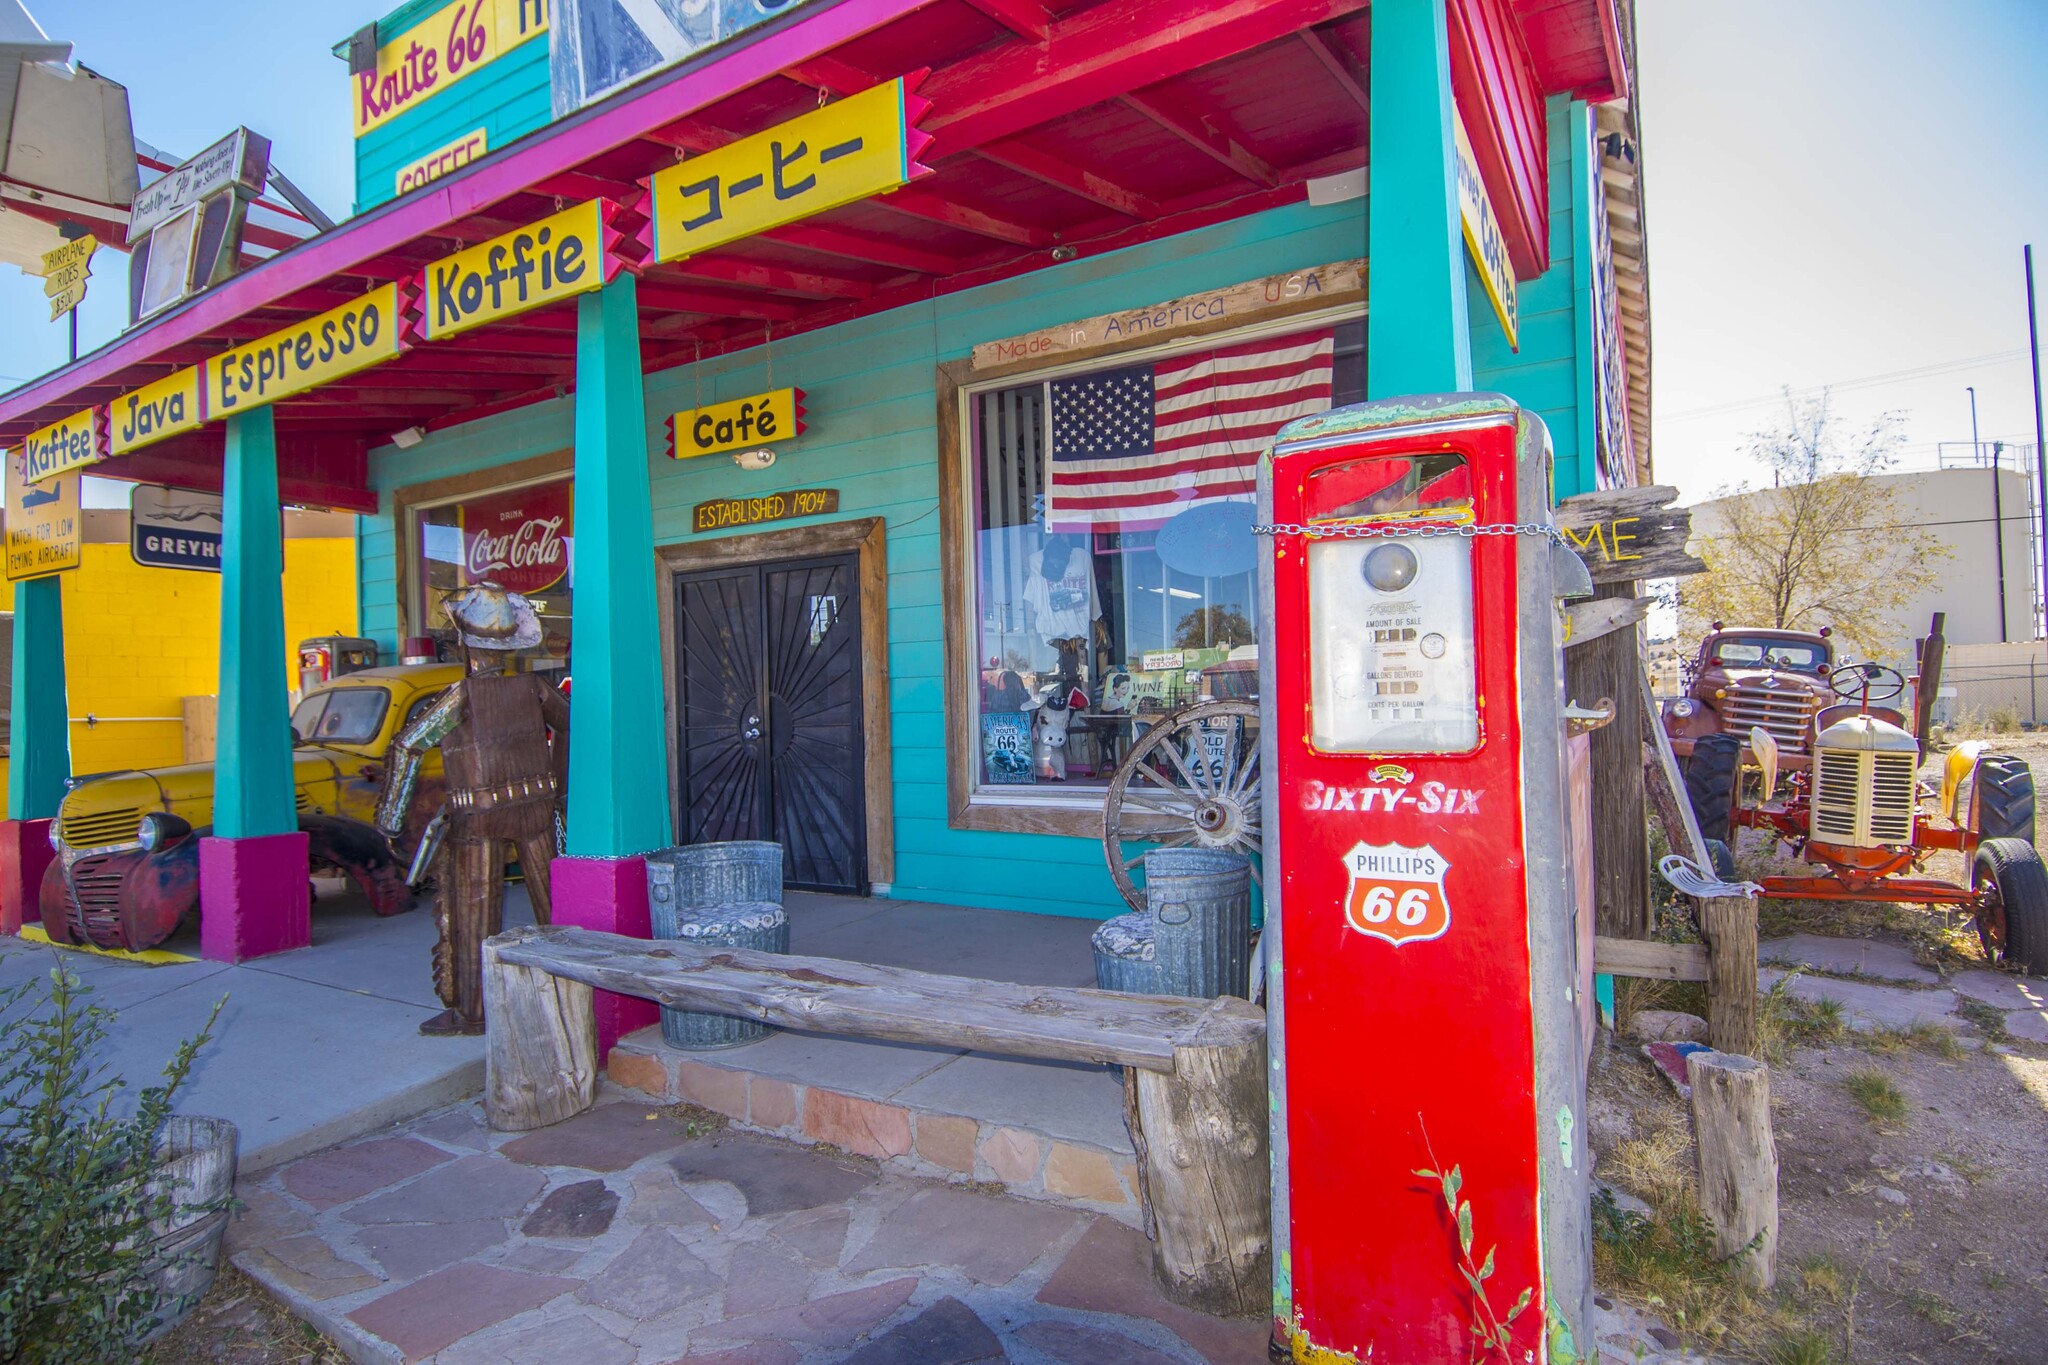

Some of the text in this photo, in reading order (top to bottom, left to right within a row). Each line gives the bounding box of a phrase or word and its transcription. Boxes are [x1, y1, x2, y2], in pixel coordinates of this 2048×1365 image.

[361, 40, 438, 127] Route
[446, 0, 486, 73] 66
[680, 137, 863, 232] コーヒー
[48, 239, 86, 270] AIRPLANE
[1481, 196, 1515, 330] Coffee
[57, 262, 79, 288] RIDES
[437, 226, 585, 326] Koffie
[998, 272, 1322, 361] Made in America USA
[220, 302, 380, 408] Espresso
[122, 391, 184, 443] Java
[693, 398, 777, 448] Café
[28, 424, 91, 477] Kaffee
[500, 509, 524, 521] DRINK
[699, 491, 826, 528] ESTABLISHED 1904
[11, 517, 73, 548] WATCH FOR LOW
[469, 515, 564, 575] Coca-Cola
[11, 541, 74, 571] FLYING AIRCRAFT
[1047, 576, 1087, 591] RUTE
[1366, 617, 1422, 628] AMOUNT OF SALE
[1133, 682, 1164, 693] WINE
[1367, 670, 1423, 679] GALLONS DELIVERED
[1368, 701, 1385, 709] CENTS
[996, 727, 1017, 735] ROUTE
[997, 735, 1017, 751] 66
[1193, 747, 1226, 756] RUTE
[1191, 759, 1224, 778] 66
[1357, 855, 1436, 876] PHILLIPS
[1362, 886, 1430, 926] 66
